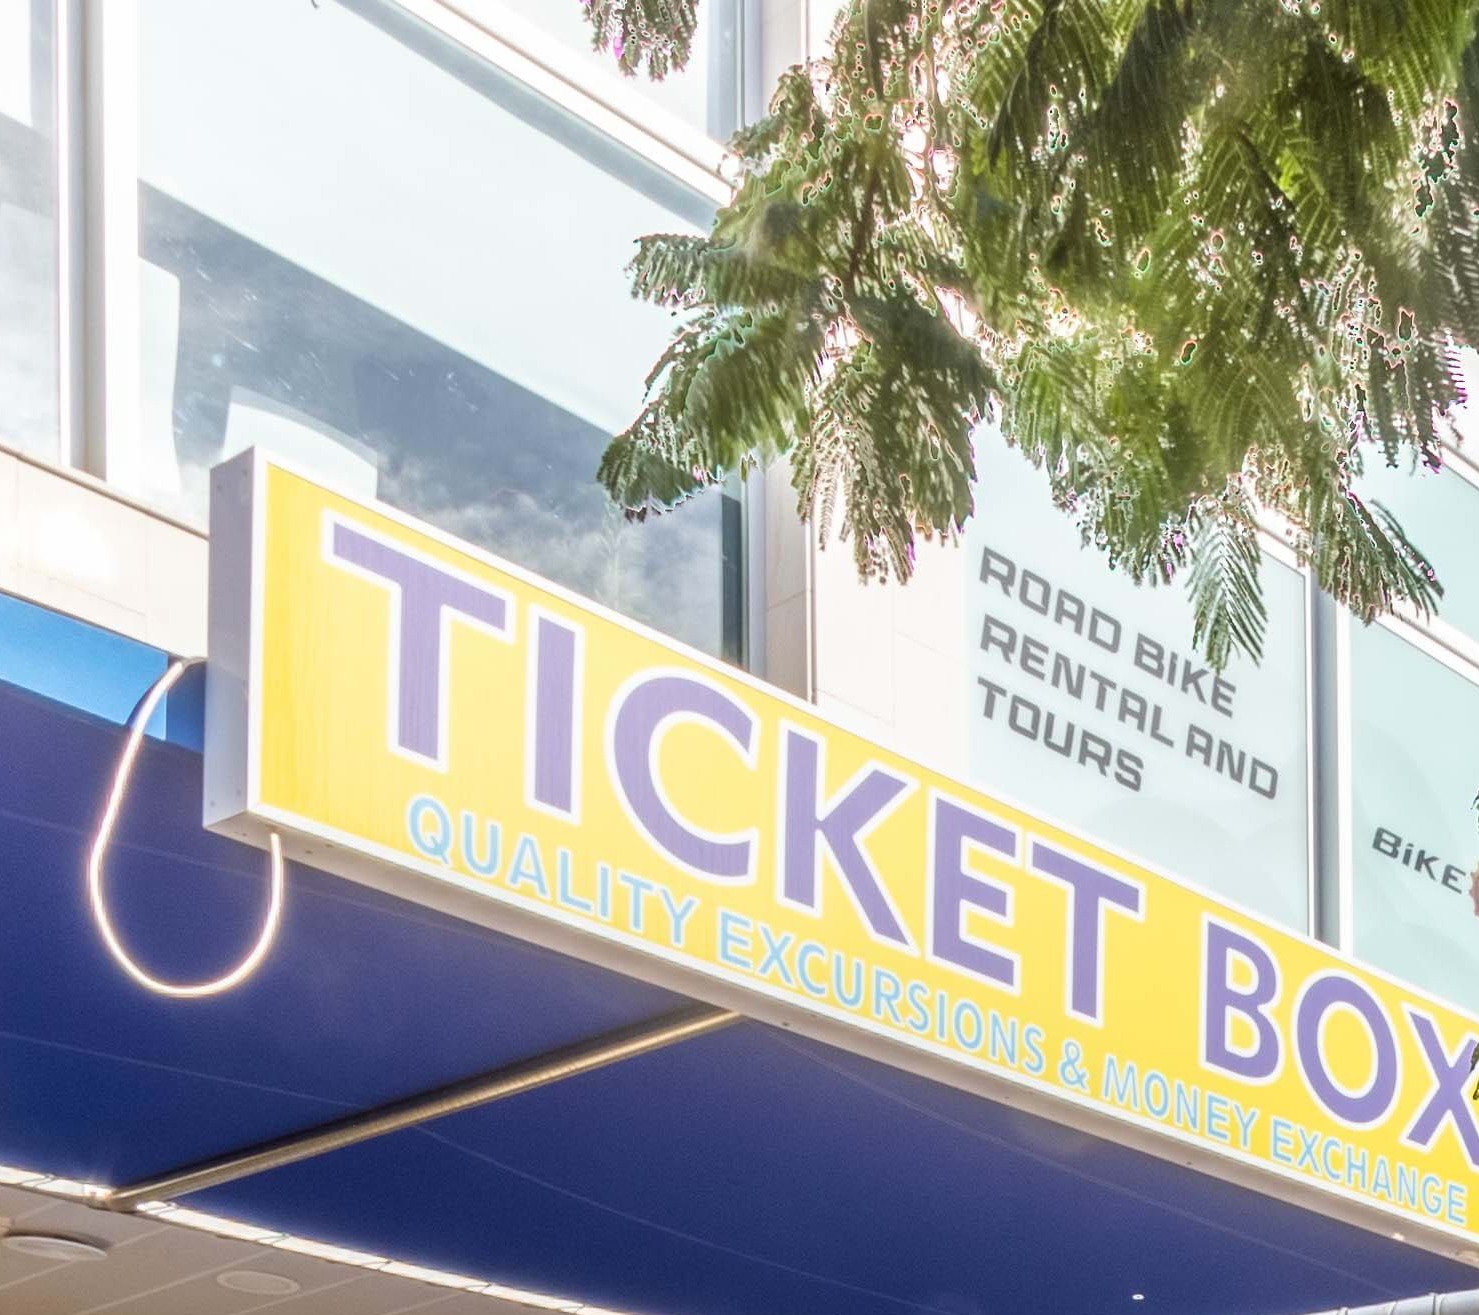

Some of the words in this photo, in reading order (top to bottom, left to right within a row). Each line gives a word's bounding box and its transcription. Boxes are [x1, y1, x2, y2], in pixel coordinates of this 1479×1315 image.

[979, 546, 1123, 655] ROAD
[324, 508, 1146, 1026] TICKET
[977, 676, 1145, 793] TOURS
[979, 614, 1175, 750] RENTAL
[1184, 730, 1280, 801] AND
[405, 795, 696, 945] QUALITY
[718, 909, 1046, 1076] EXCURSIONS
[1059, 1040, 1090, 1090] &
[1102, 1061, 1257, 1150] MONEY
[1271, 1117, 1468, 1226] EXCHANGE
